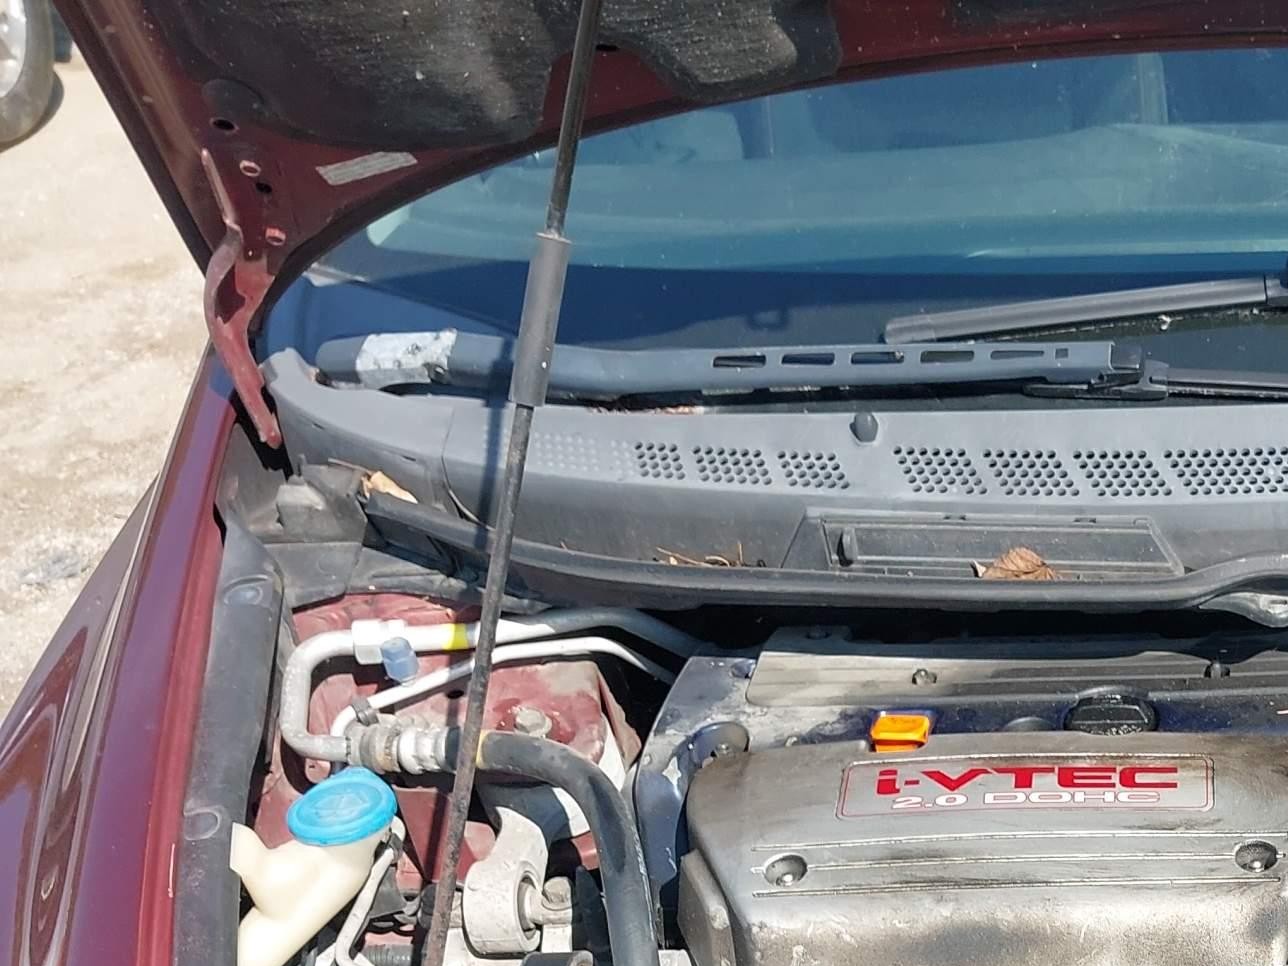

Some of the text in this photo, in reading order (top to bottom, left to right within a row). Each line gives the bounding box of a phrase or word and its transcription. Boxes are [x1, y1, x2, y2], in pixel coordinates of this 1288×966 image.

[876, 766, 1178, 795] i-VTEC
[891, 791, 1160, 809] 2.0 DOHC
